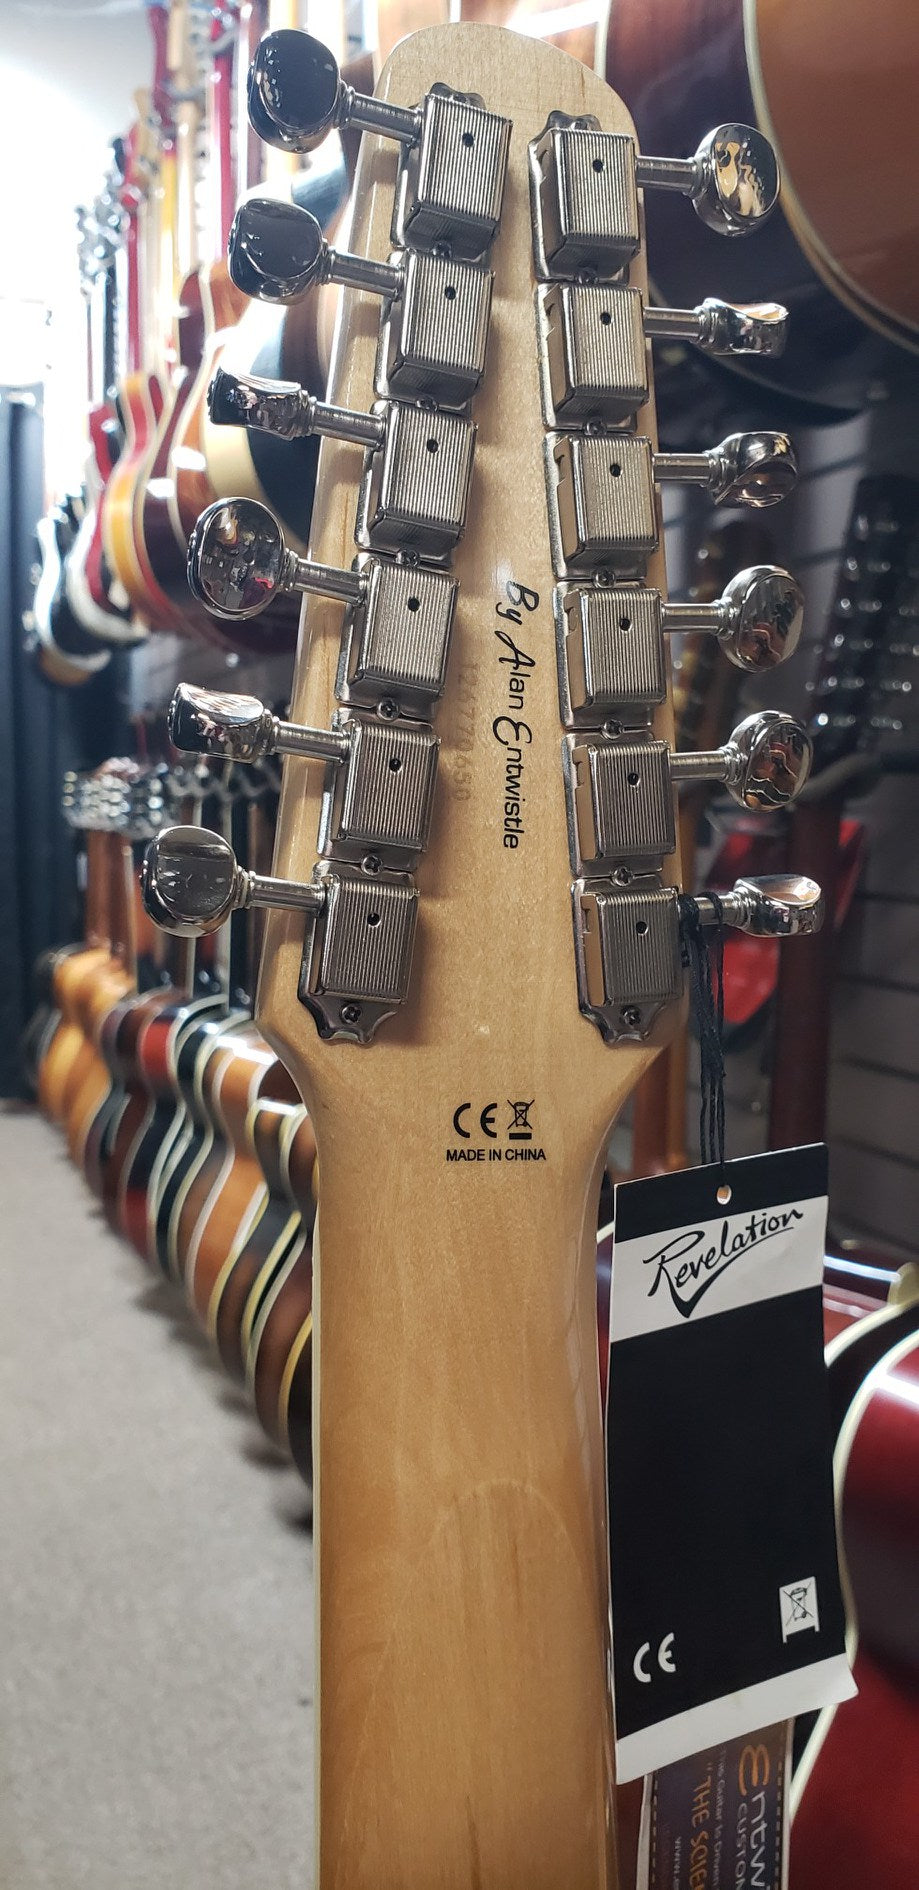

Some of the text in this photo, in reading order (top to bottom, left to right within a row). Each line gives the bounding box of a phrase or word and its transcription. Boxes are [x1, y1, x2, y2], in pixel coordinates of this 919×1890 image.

[492, 580, 540, 850] By Alan Entwistle
[446, 1148, 547, 1161] MADE IN CHINA
[453, 1102, 498, 1139] CE
[643, 1208, 804, 1319] Revelation
[738, 1743, 771, 1890] Entw
